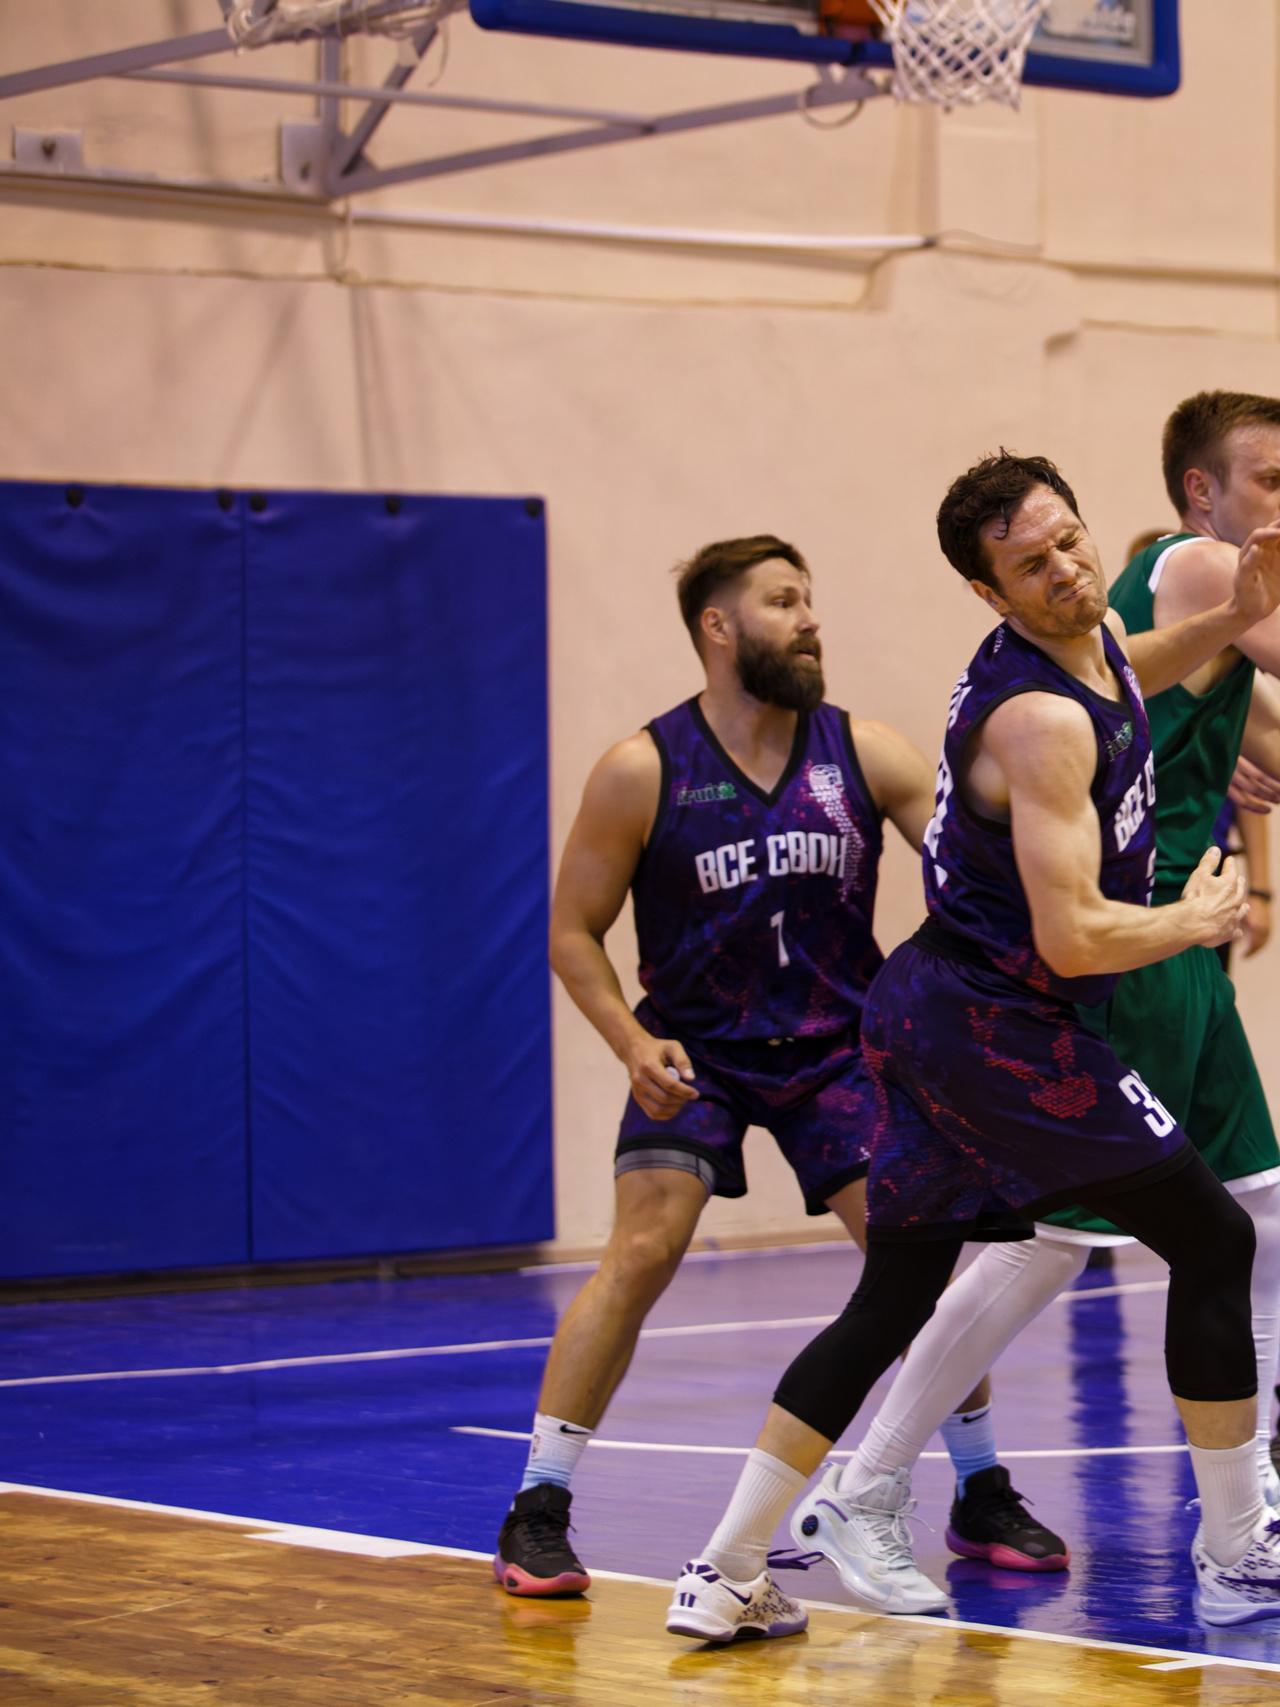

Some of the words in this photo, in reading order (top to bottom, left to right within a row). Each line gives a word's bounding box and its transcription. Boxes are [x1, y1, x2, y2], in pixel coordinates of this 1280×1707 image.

[694, 838, 758, 894] ВСЕ
[766, 831, 847, 878] СВОИ
[1118, 1068, 1177, 1138] 3
